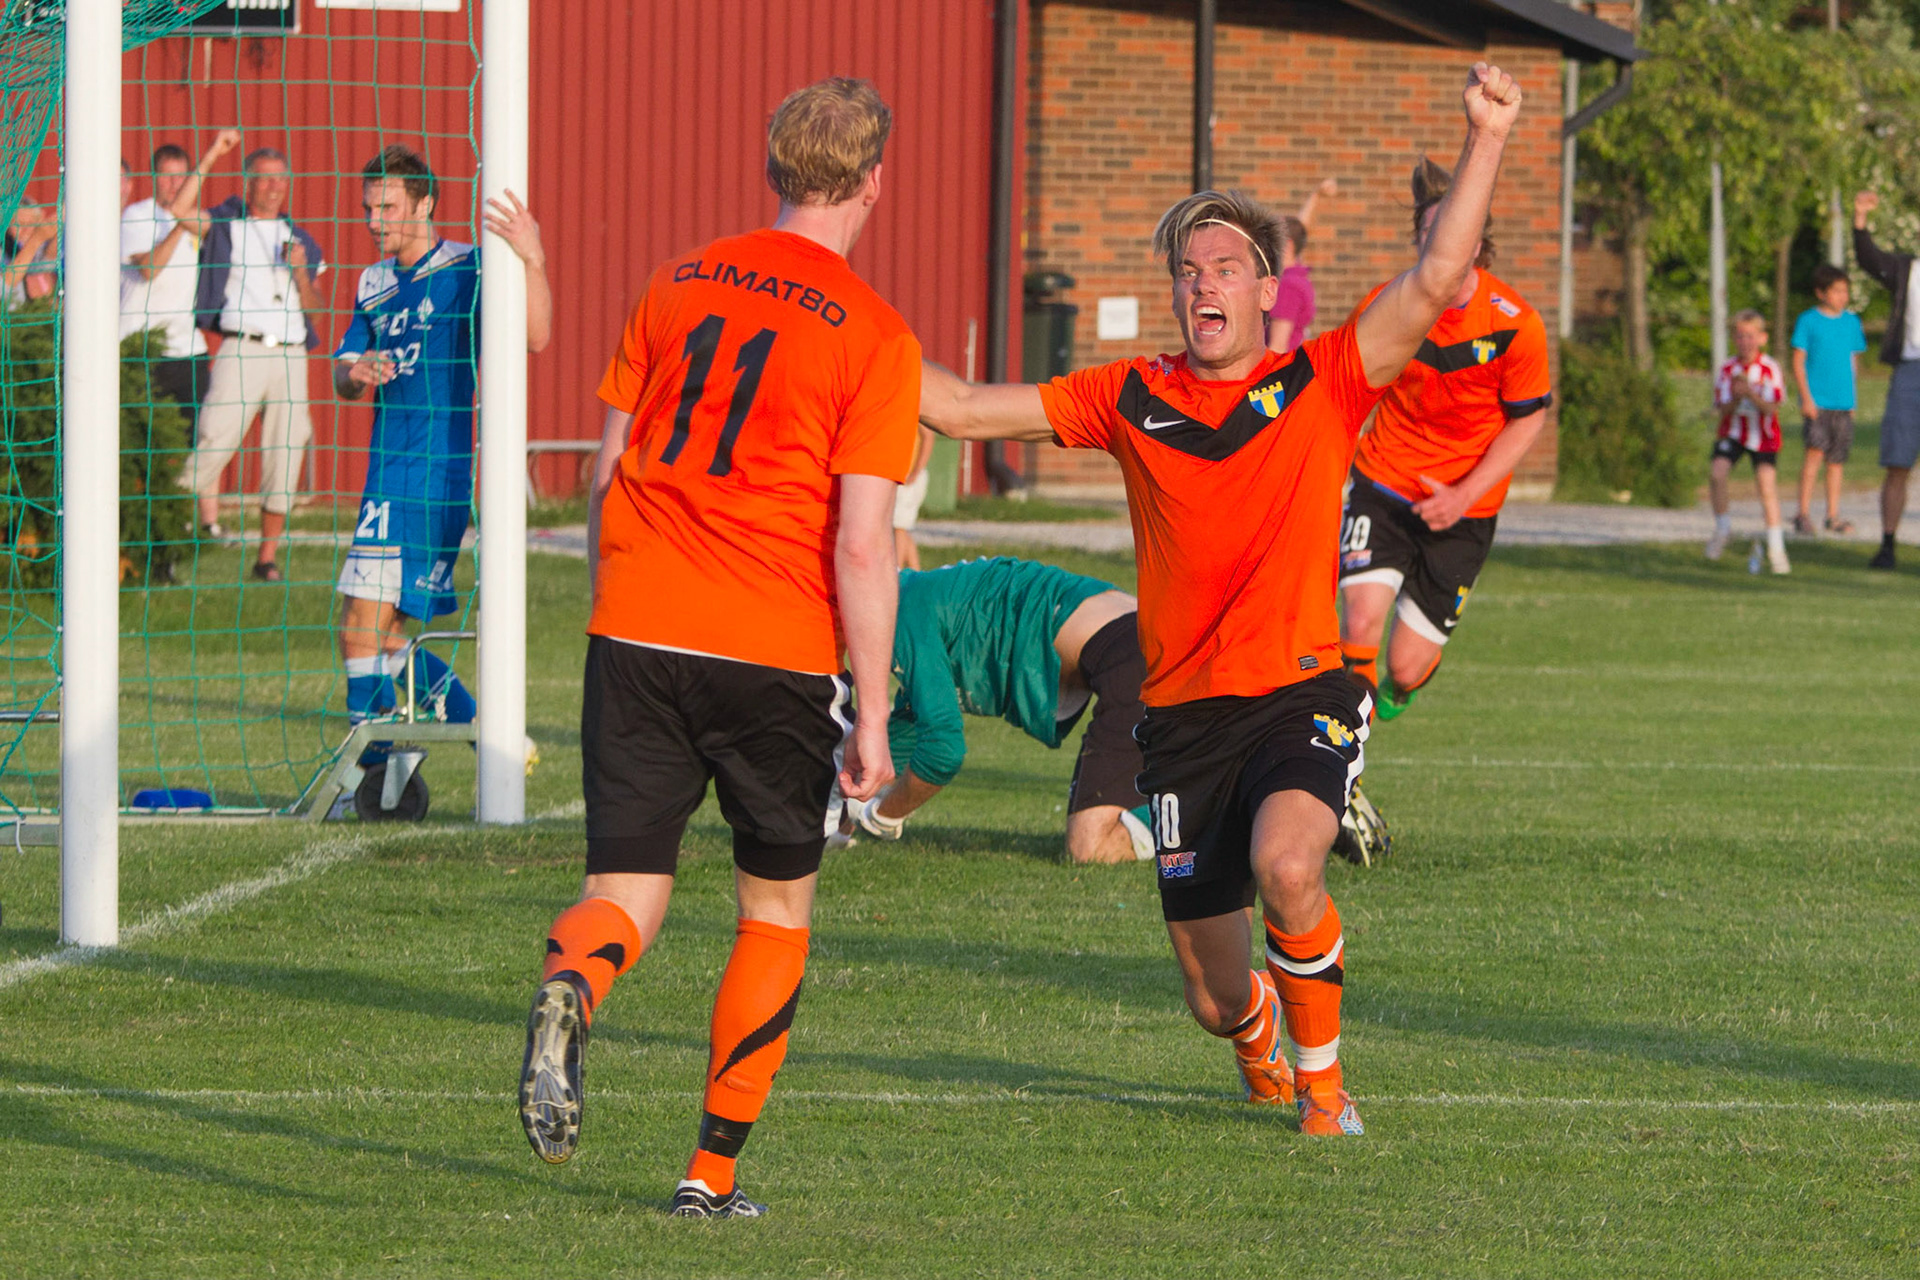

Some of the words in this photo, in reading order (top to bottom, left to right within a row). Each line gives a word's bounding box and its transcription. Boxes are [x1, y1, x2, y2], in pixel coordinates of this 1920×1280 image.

[673, 260, 847, 328] CLIMAT80
[659, 313, 778, 478] 11
[355, 499, 391, 540] 21
[1152, 792, 1181, 850] 10
[1162, 864, 1194, 878] SPORT
